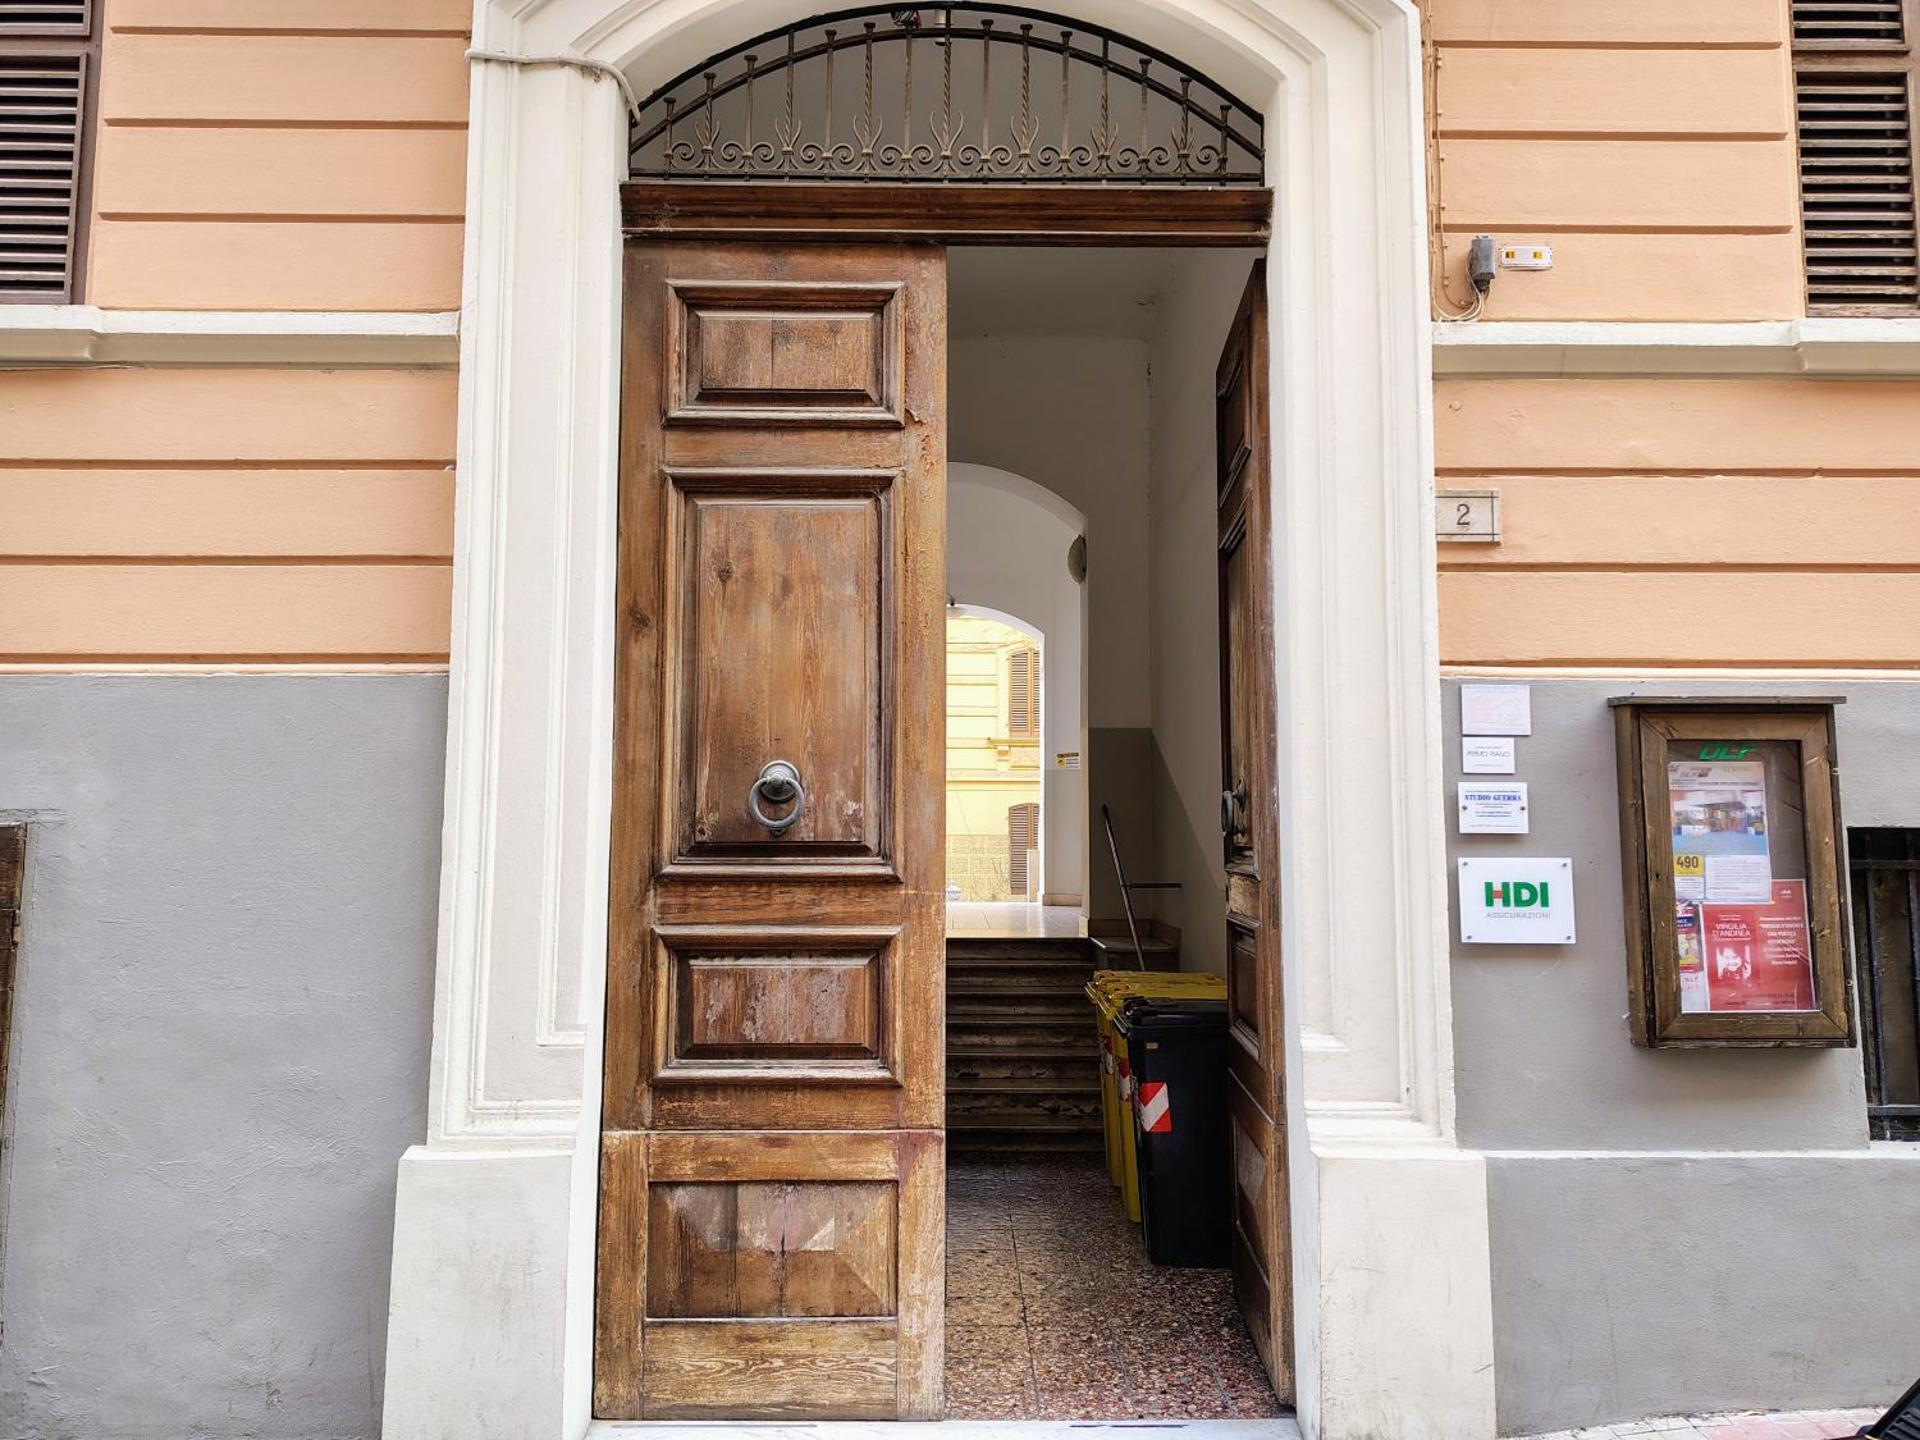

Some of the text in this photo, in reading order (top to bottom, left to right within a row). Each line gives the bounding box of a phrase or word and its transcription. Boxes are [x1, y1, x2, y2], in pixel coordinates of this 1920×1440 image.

[1456, 503, 1470, 526] 2
[1676, 855, 1699, 869] 490
[1484, 881, 1550, 908] HDI
